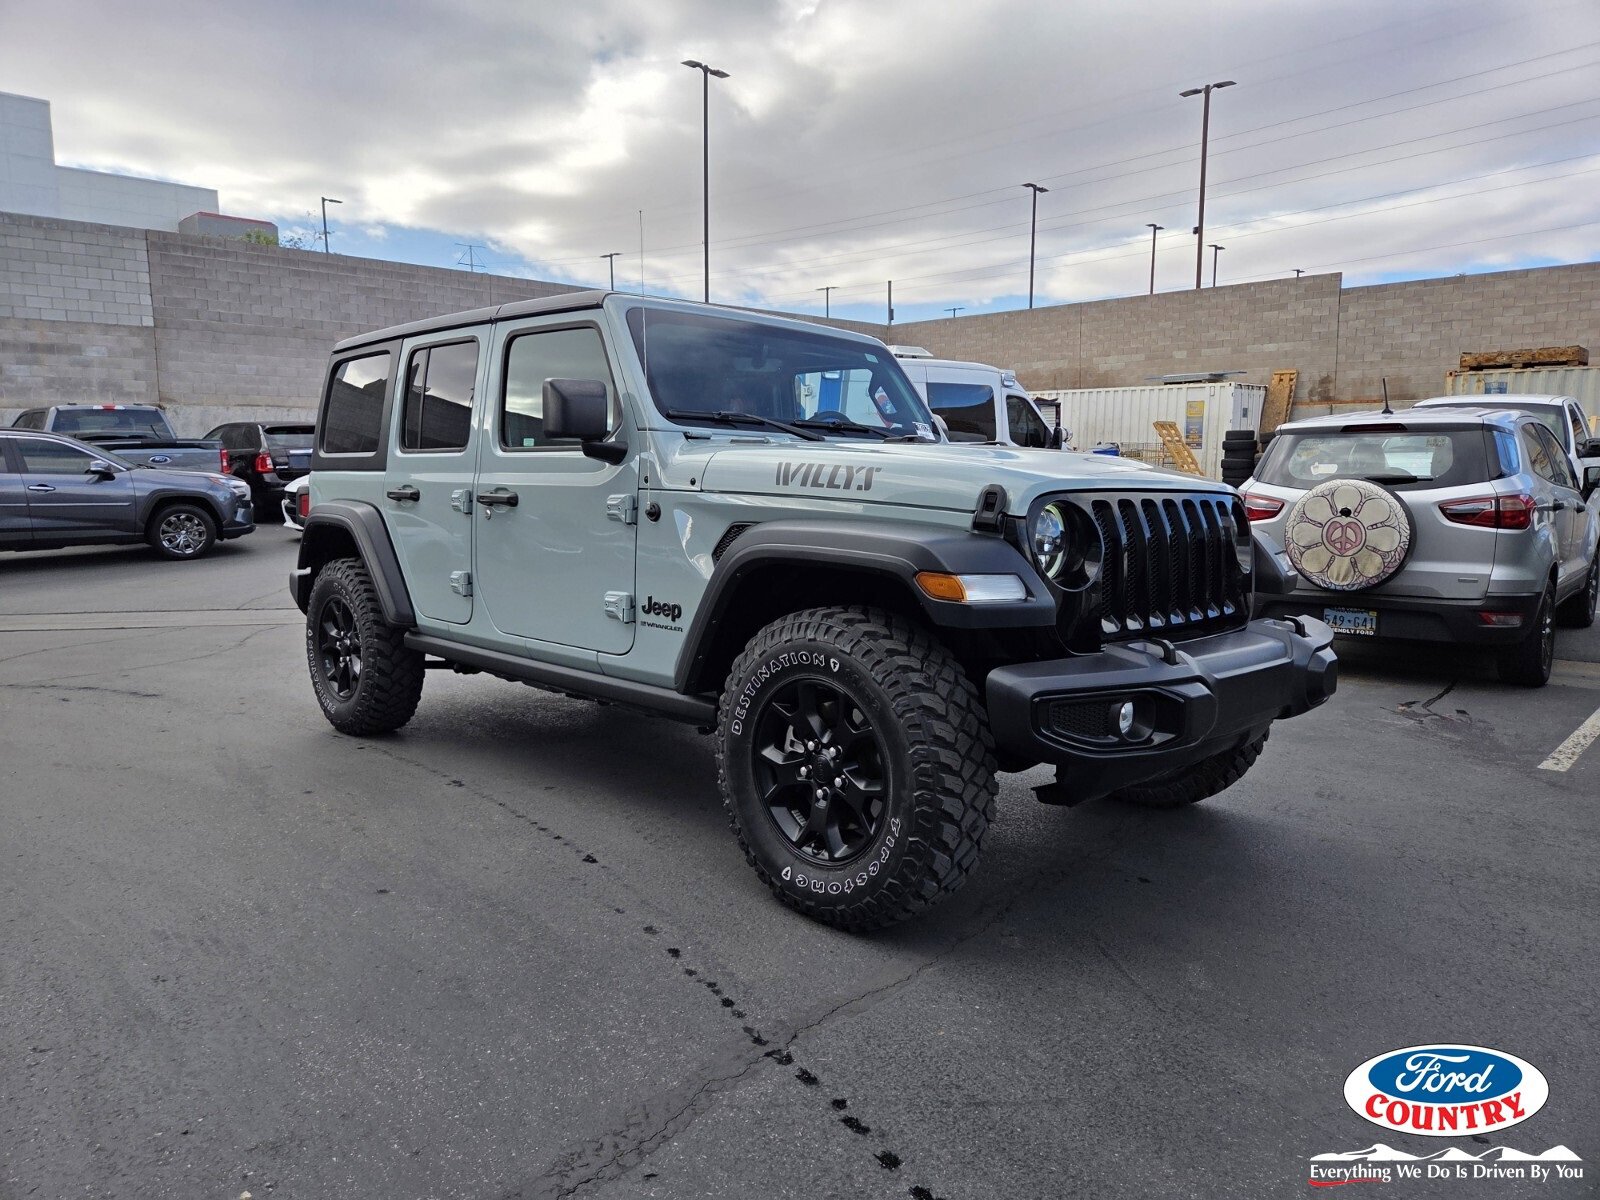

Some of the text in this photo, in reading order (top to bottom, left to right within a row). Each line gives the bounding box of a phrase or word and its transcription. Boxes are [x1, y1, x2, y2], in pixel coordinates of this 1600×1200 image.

[776, 461, 882, 491] WILLYS
[641, 595, 682, 622] Jeep
[646, 622, 684, 632] WRANGLER
[731, 651, 825, 736] DESTINATION
